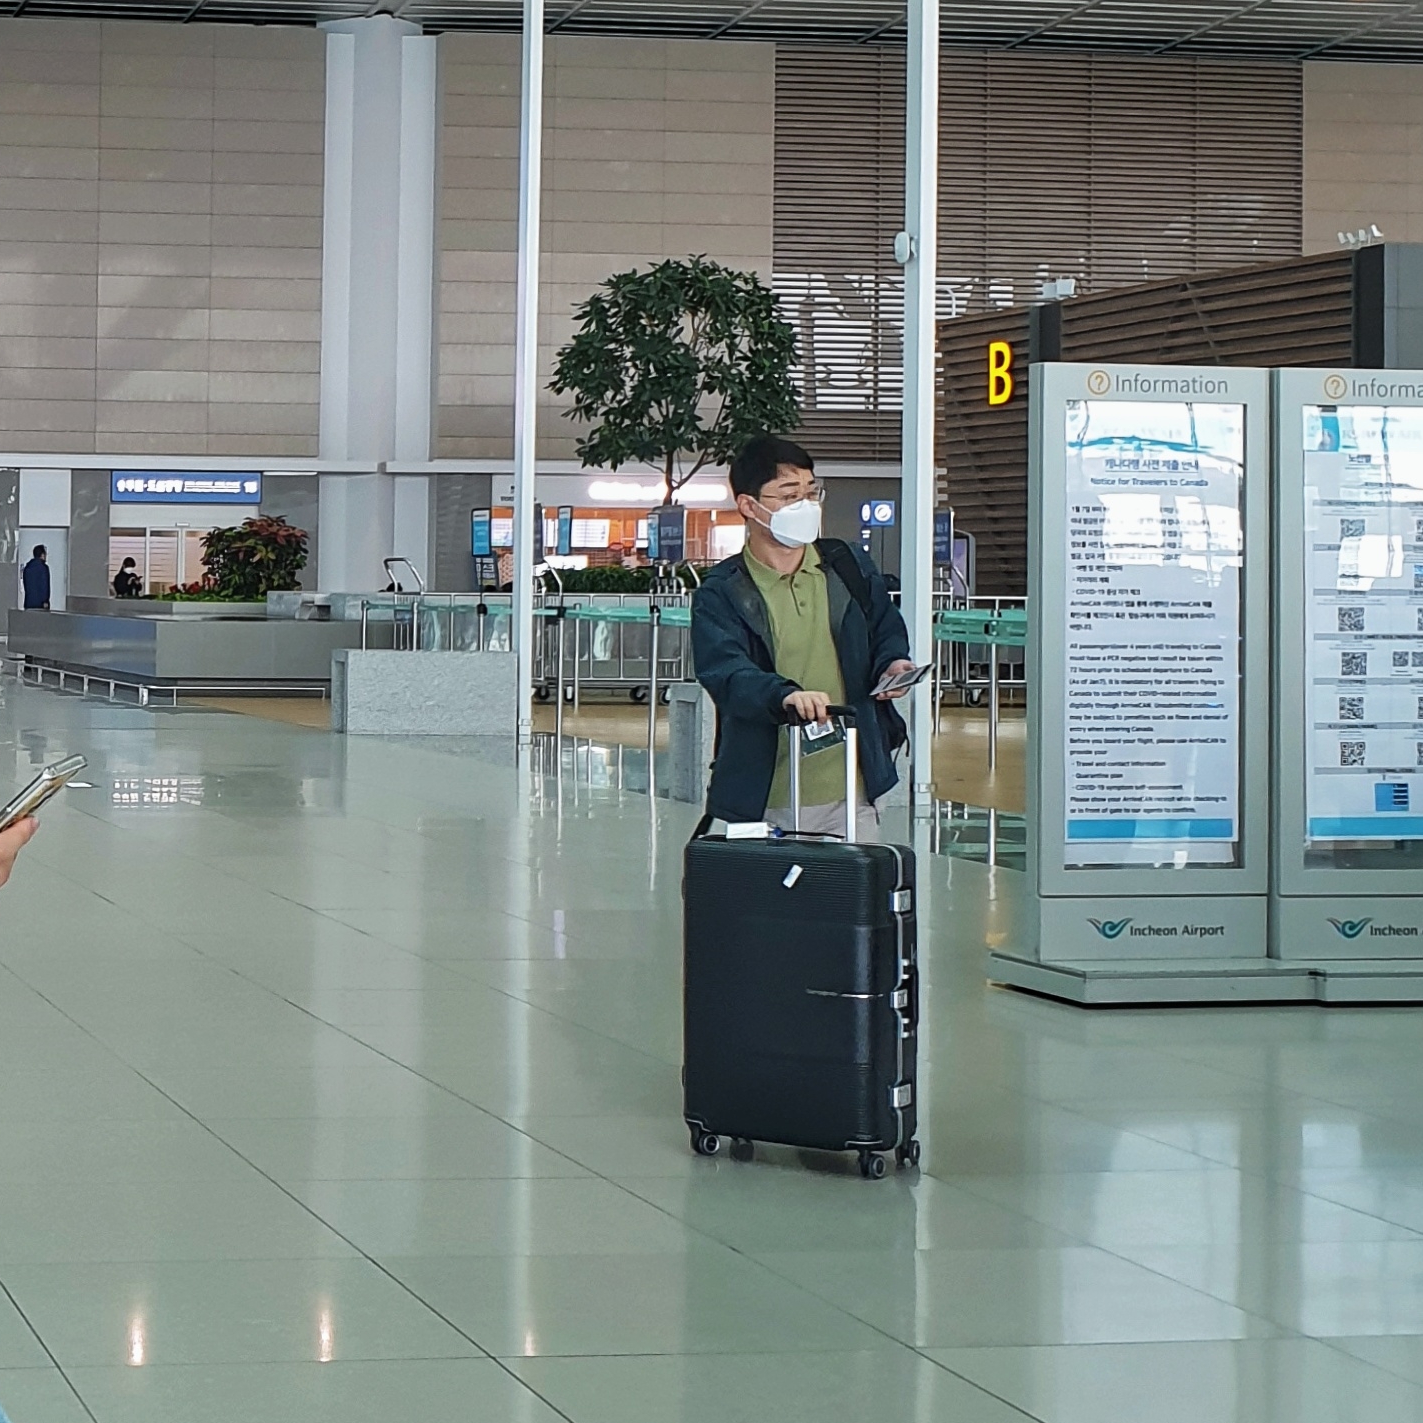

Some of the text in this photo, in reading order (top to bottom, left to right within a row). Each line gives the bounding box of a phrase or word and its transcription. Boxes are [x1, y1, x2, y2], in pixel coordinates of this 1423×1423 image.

[988, 341, 1013, 405] B
[1115, 373, 1228, 394] Information
[1352, 377, 1423, 399] Informa
[1129, 924, 1225, 938] Incheon Airport
[1370, 924, 1419, 937] Incheon
